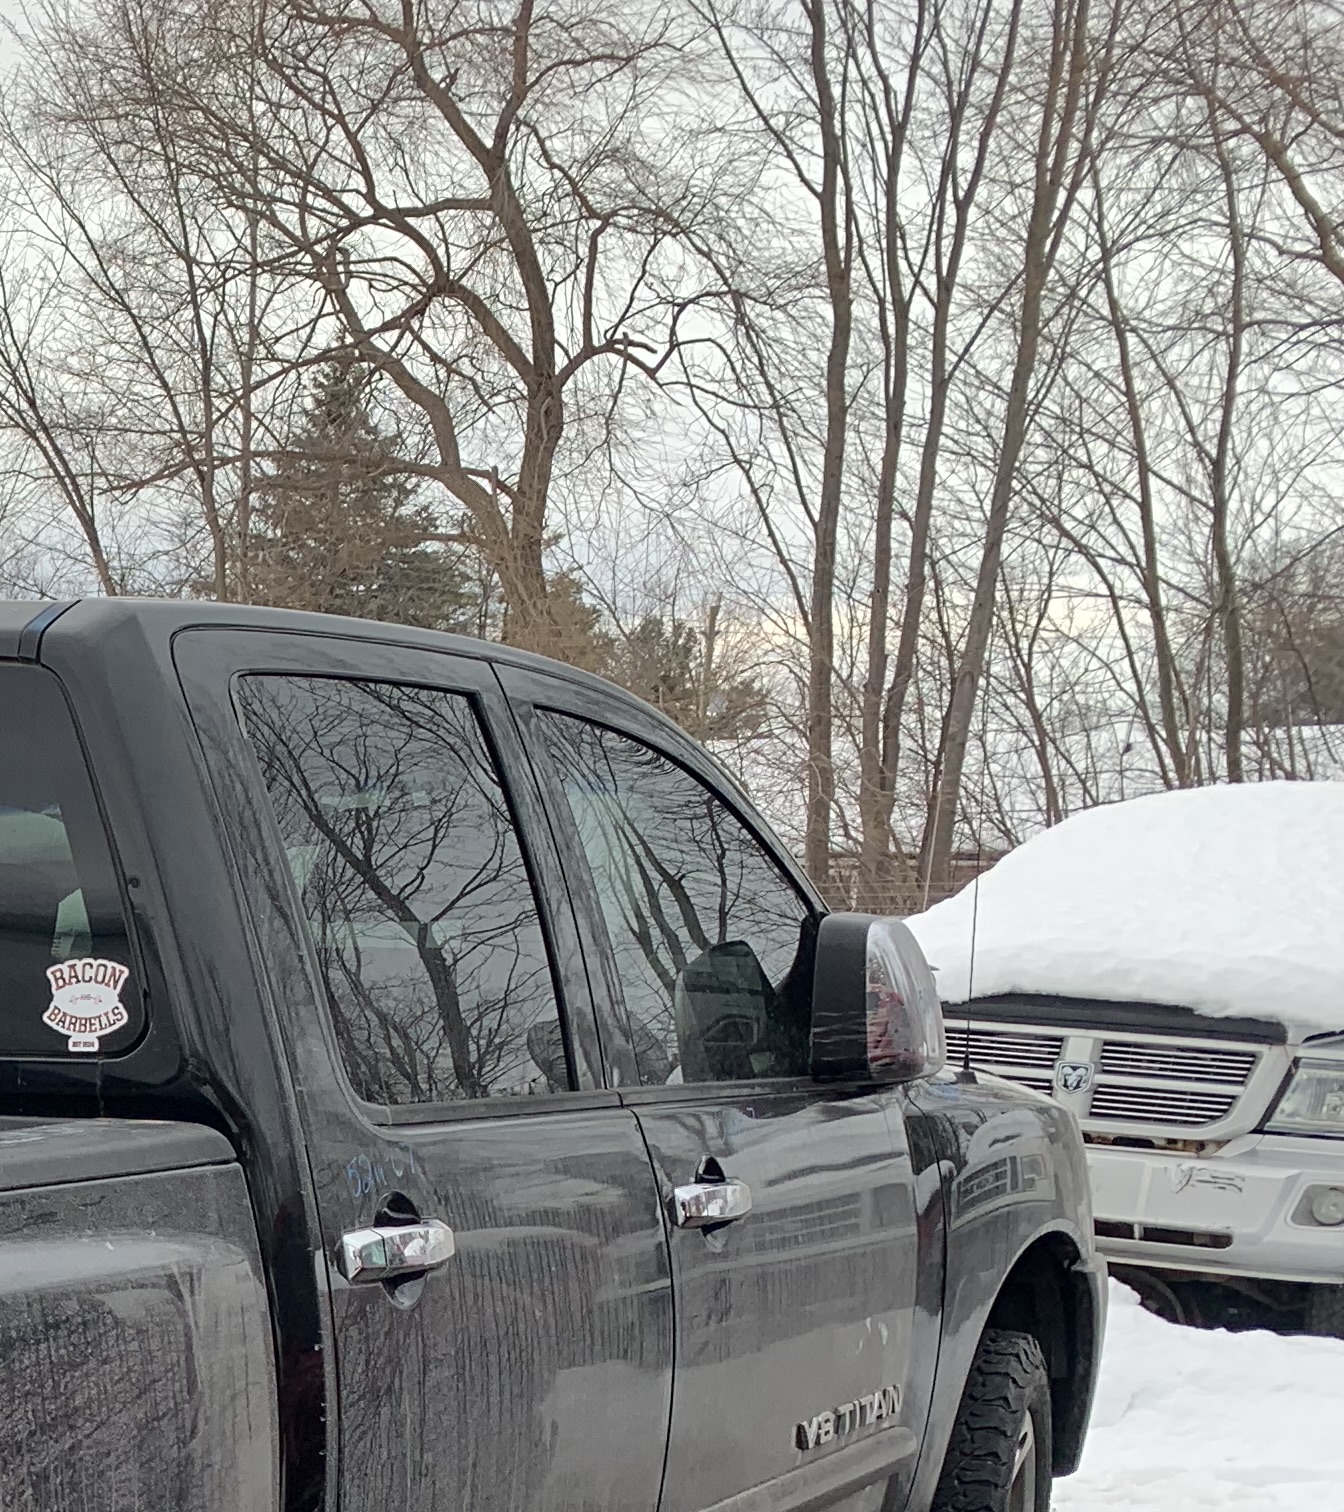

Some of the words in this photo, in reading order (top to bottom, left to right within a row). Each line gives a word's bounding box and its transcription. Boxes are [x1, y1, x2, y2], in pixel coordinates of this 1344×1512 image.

[50, 962, 125, 992] BACON
[47, 1005, 124, 1034] BARBELLS
[836, 1383, 904, 1436] TITAN
